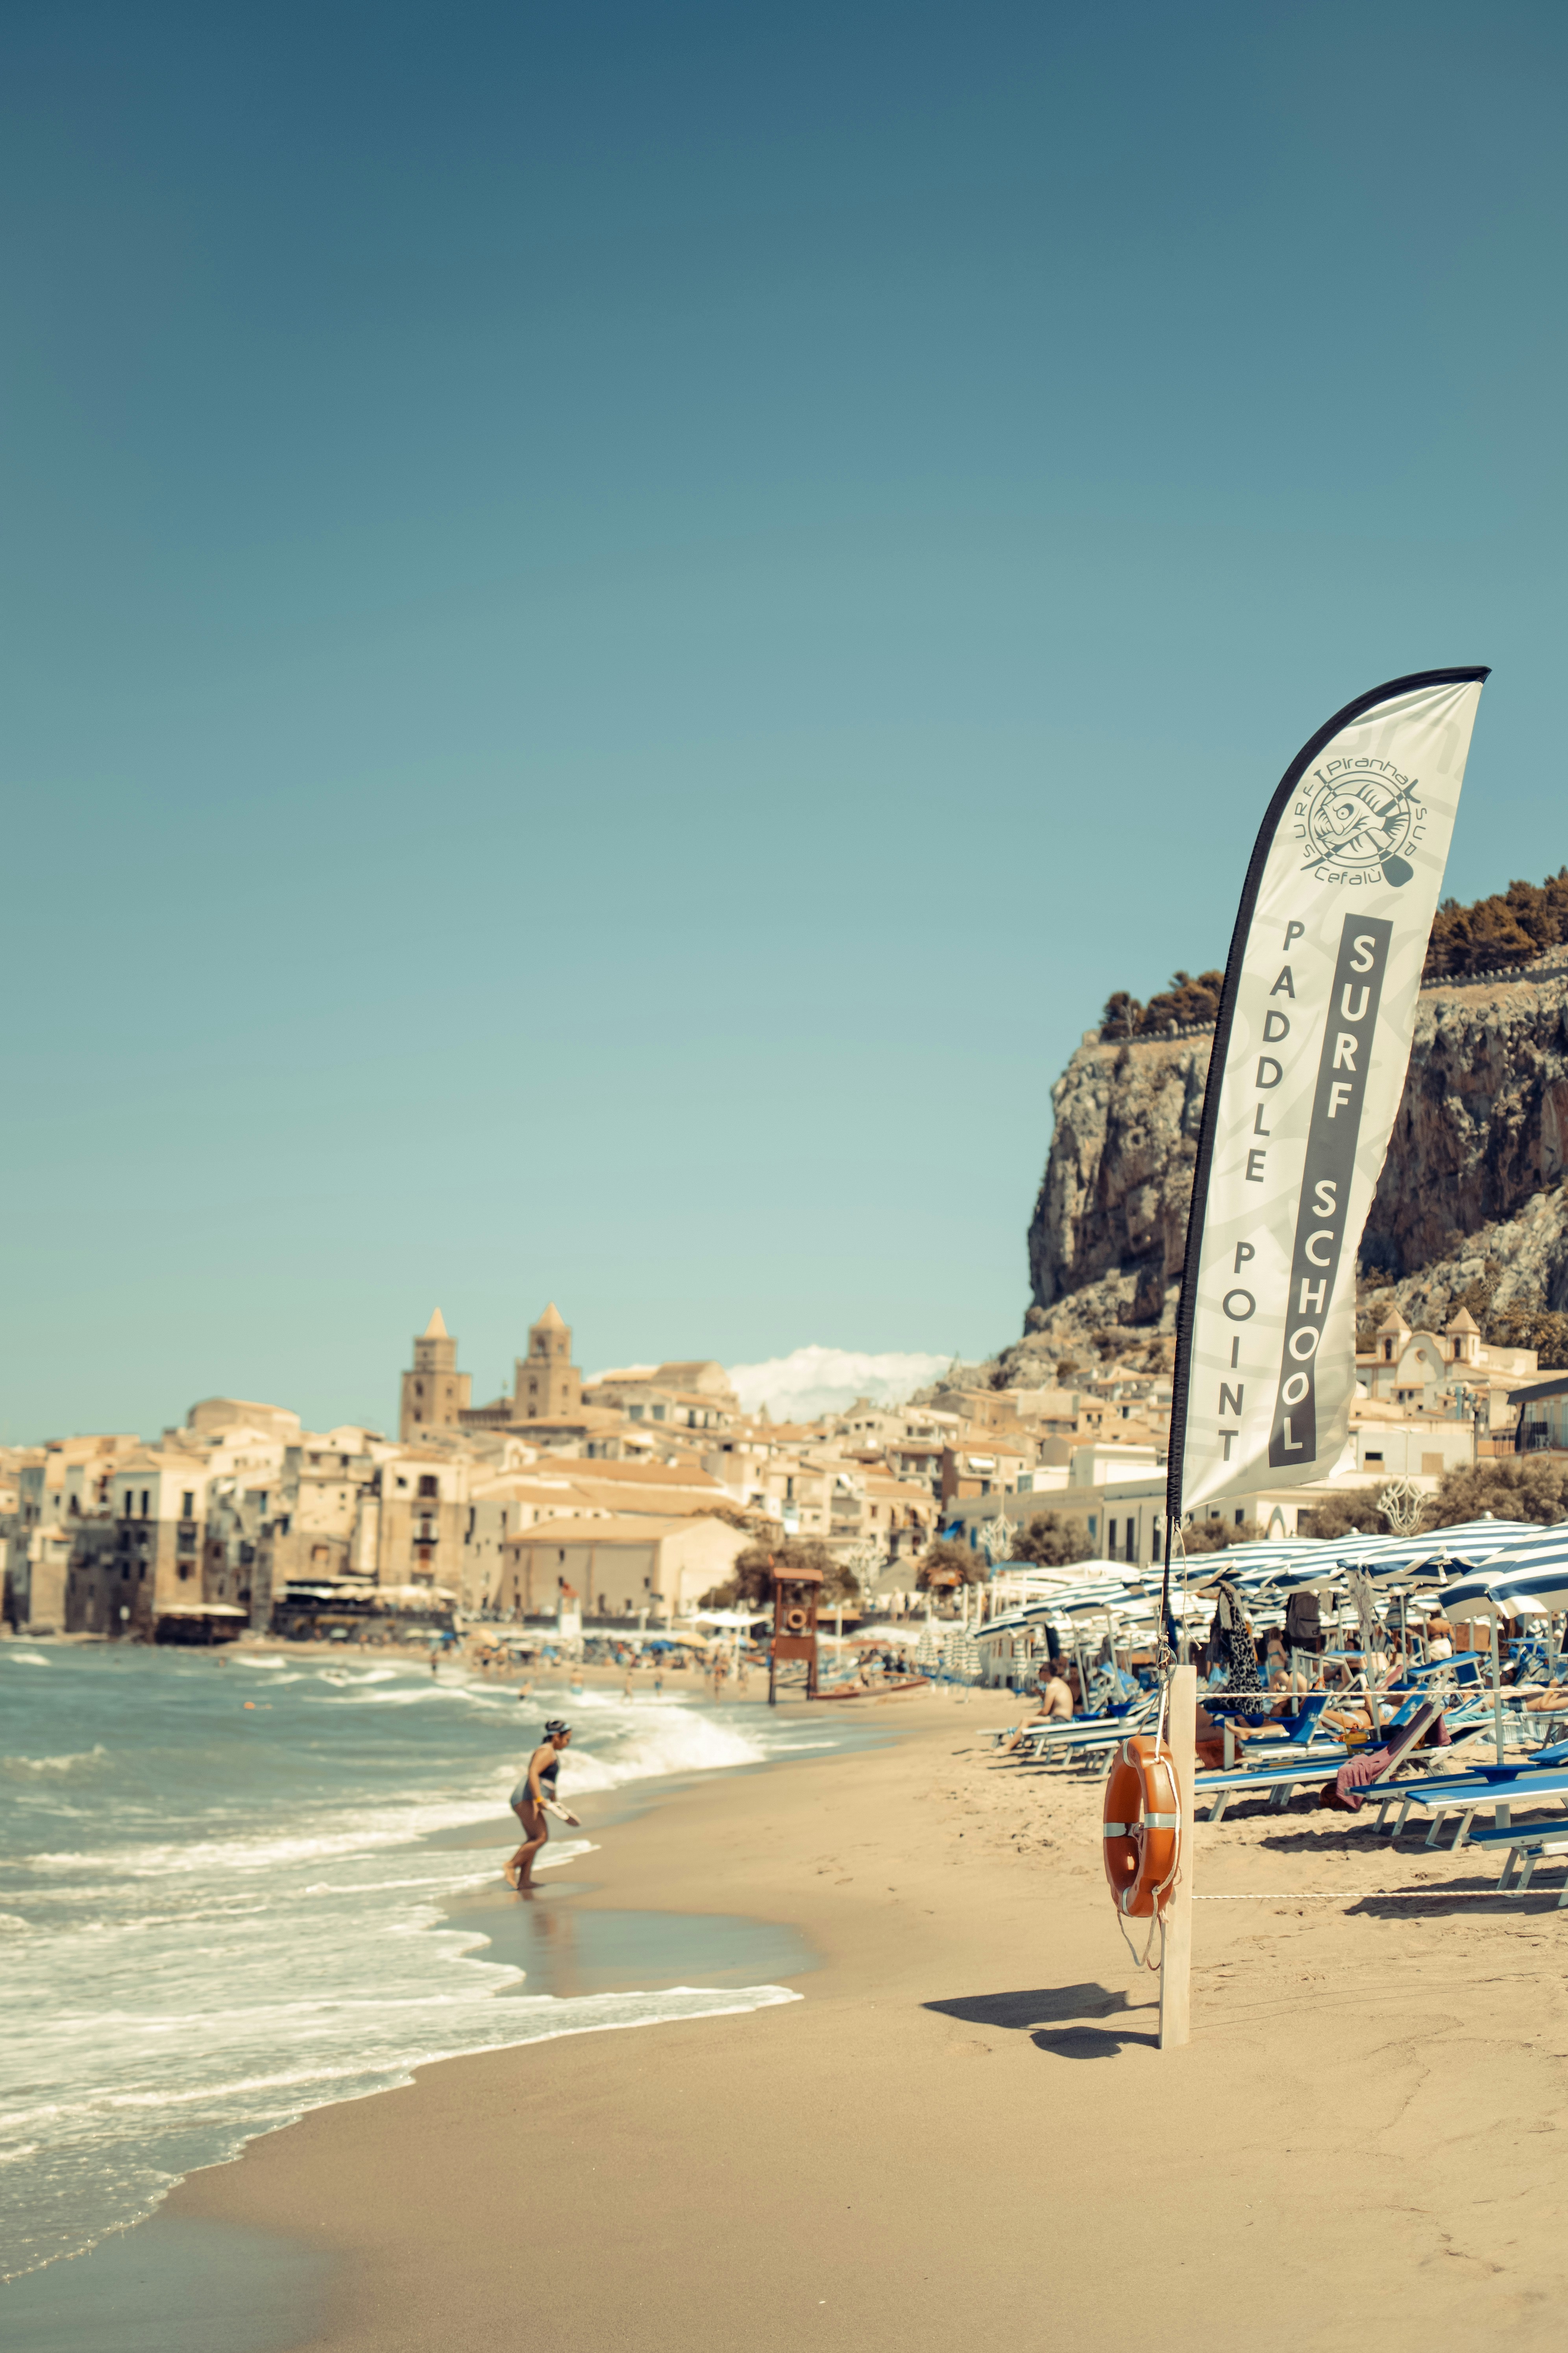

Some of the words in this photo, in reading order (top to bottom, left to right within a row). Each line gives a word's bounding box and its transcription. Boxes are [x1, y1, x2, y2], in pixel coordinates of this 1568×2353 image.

[1293, 784, 1314, 858] SURF
[1326, 757, 1409, 786] Piranha
[1404, 807, 1427, 857] SUP
[1314, 866, 1382, 885] Cefalù
[1245, 920, 1305, 1183] PADDLE
[1327, 935, 1376, 1118] SURF
[1218, 1241, 1256, 1462] POINT
[1282, 1179, 1337, 1450] SCHOOL
